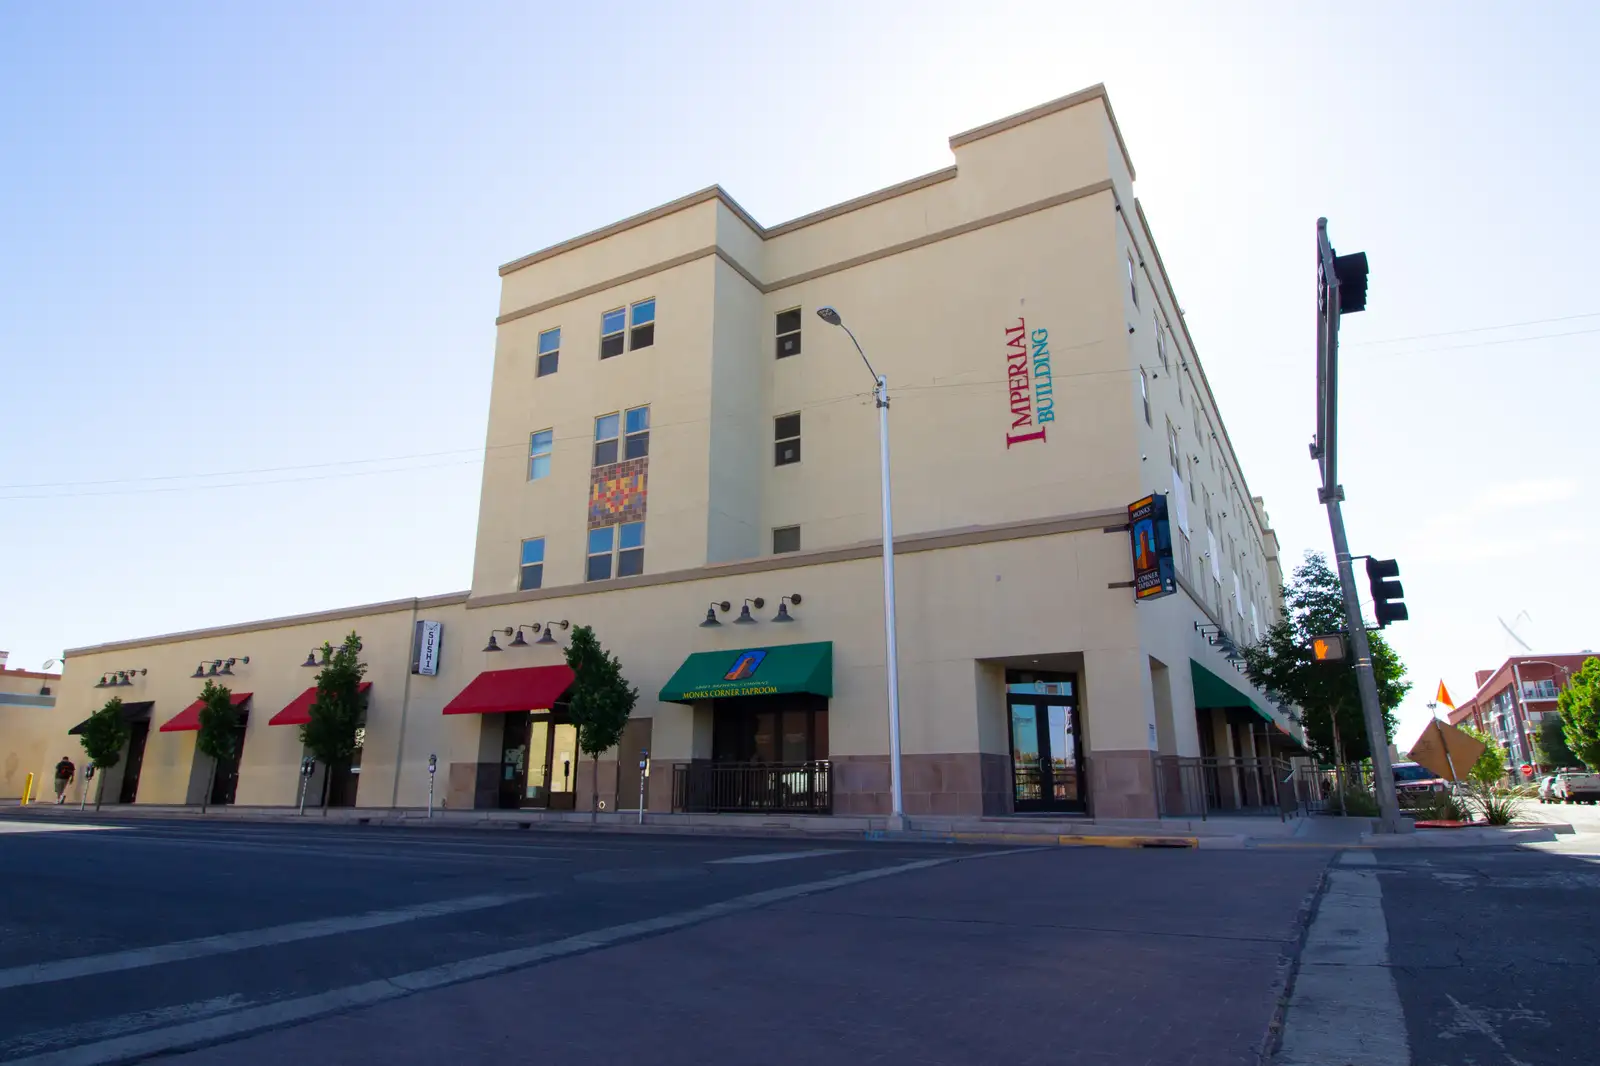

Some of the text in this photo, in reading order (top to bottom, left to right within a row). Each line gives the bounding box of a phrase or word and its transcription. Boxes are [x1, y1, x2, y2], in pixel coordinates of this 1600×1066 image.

[1005, 317, 1047, 450] IMPERIAL
[1031, 327, 1055, 424] BUILDING
[1138, 572, 1159, 584] CORNER
[1138, 579, 1161, 590] TAPROOM
[426, 631, 434, 668] SUSHI
[683, 686, 778, 699] MONKS CORNER TAPROOM
